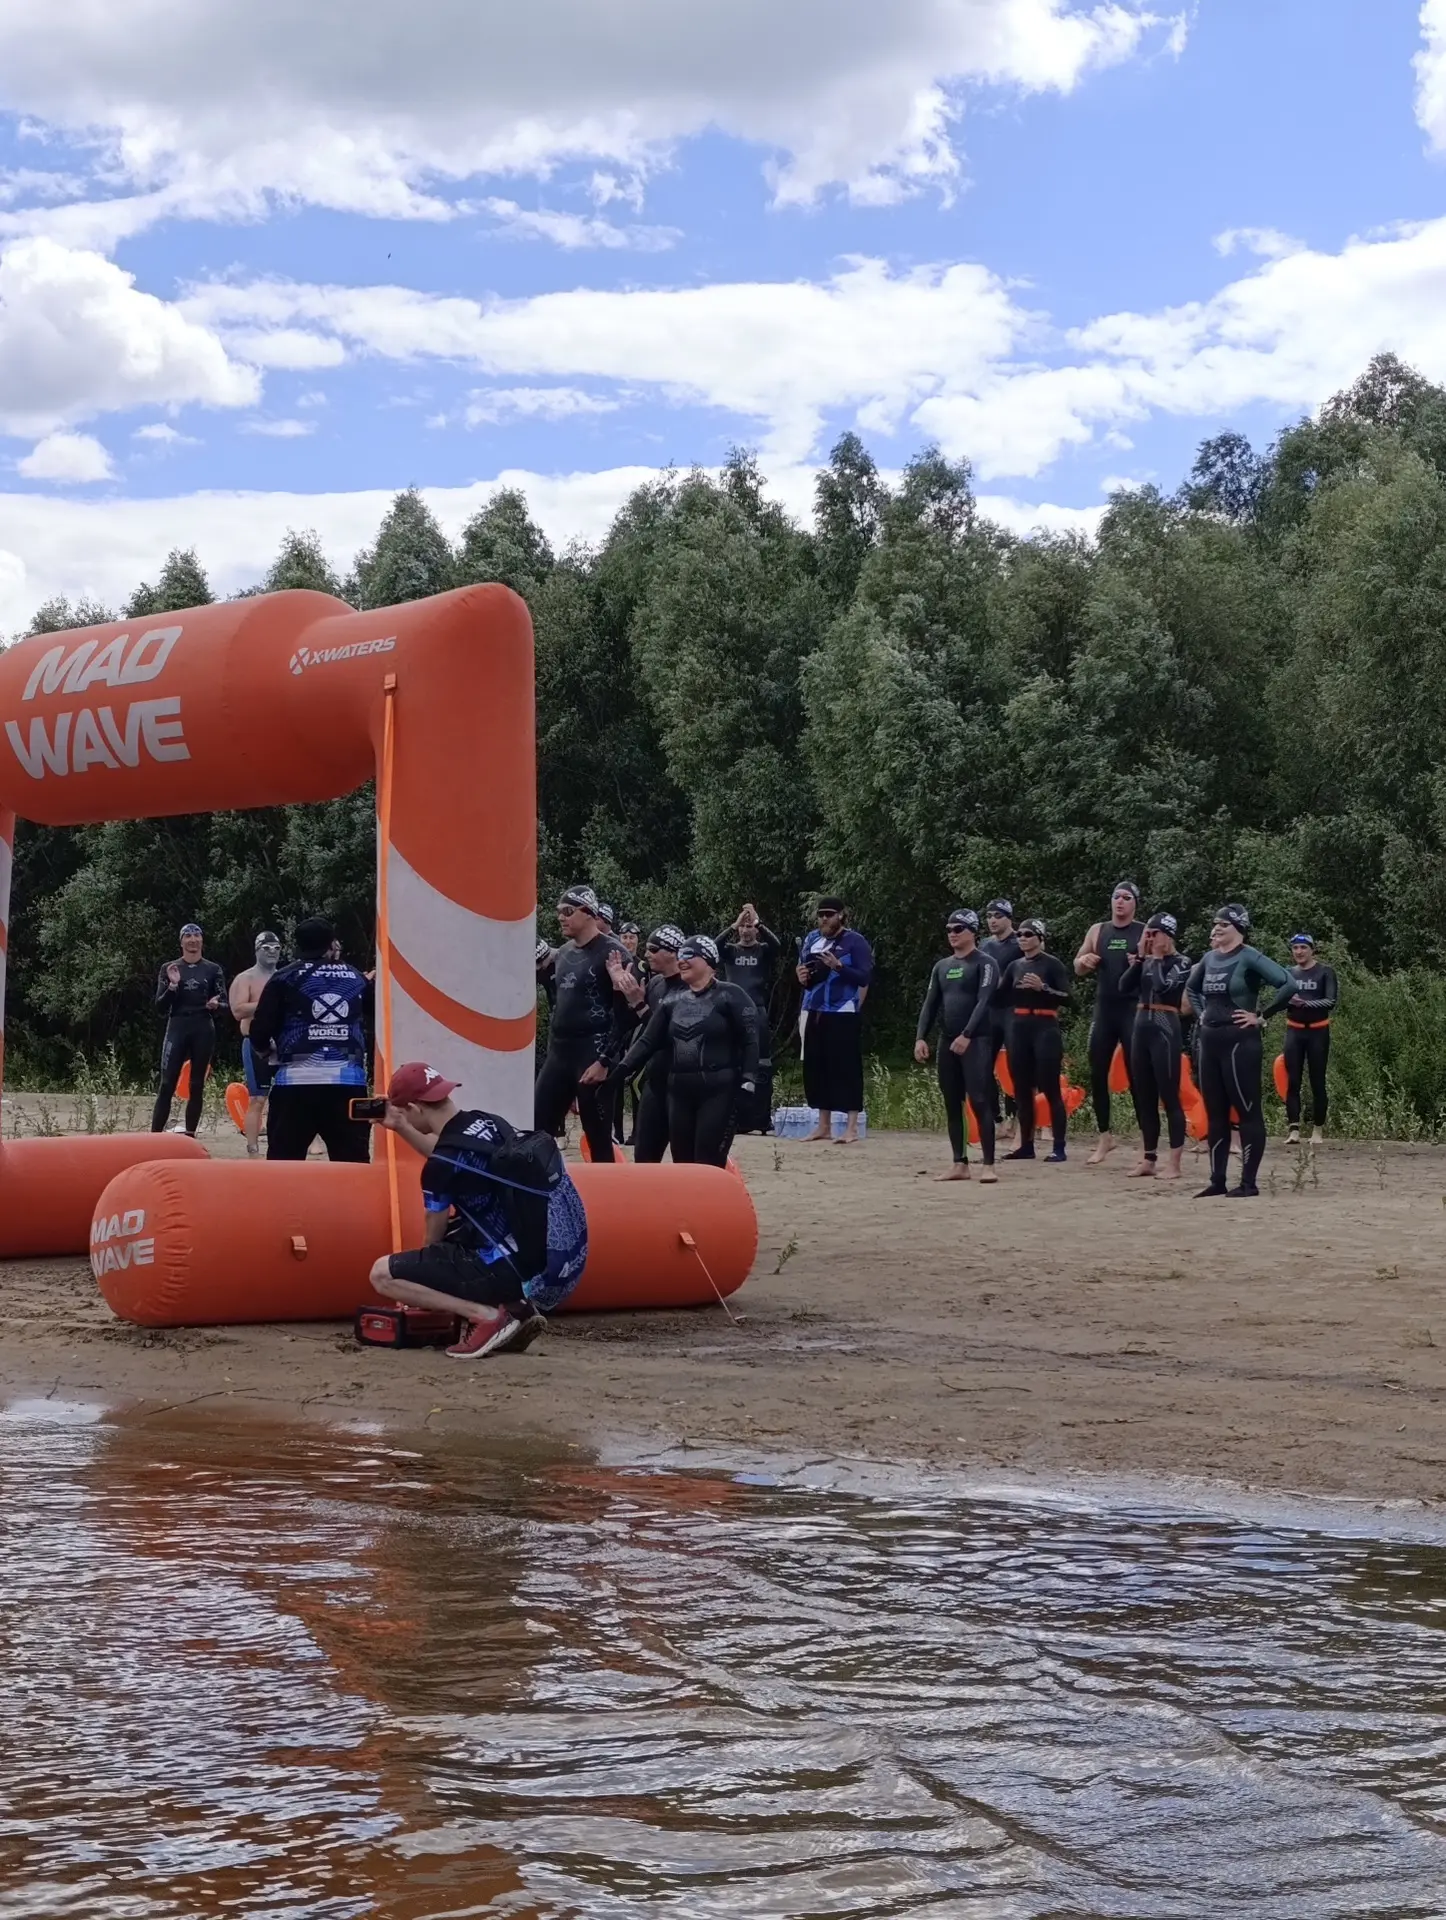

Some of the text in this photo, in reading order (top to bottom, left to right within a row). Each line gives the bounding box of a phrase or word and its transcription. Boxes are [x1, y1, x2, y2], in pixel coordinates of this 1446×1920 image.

[22, 626, 183, 700] MAD
[4, 696, 192, 780] WAVE
[735, 956, 758, 966] dhb
[1296, 979, 1318, 990] hb
[308, 1028, 349, 1036] WORLD
[91, 1209, 145, 1246] MAD
